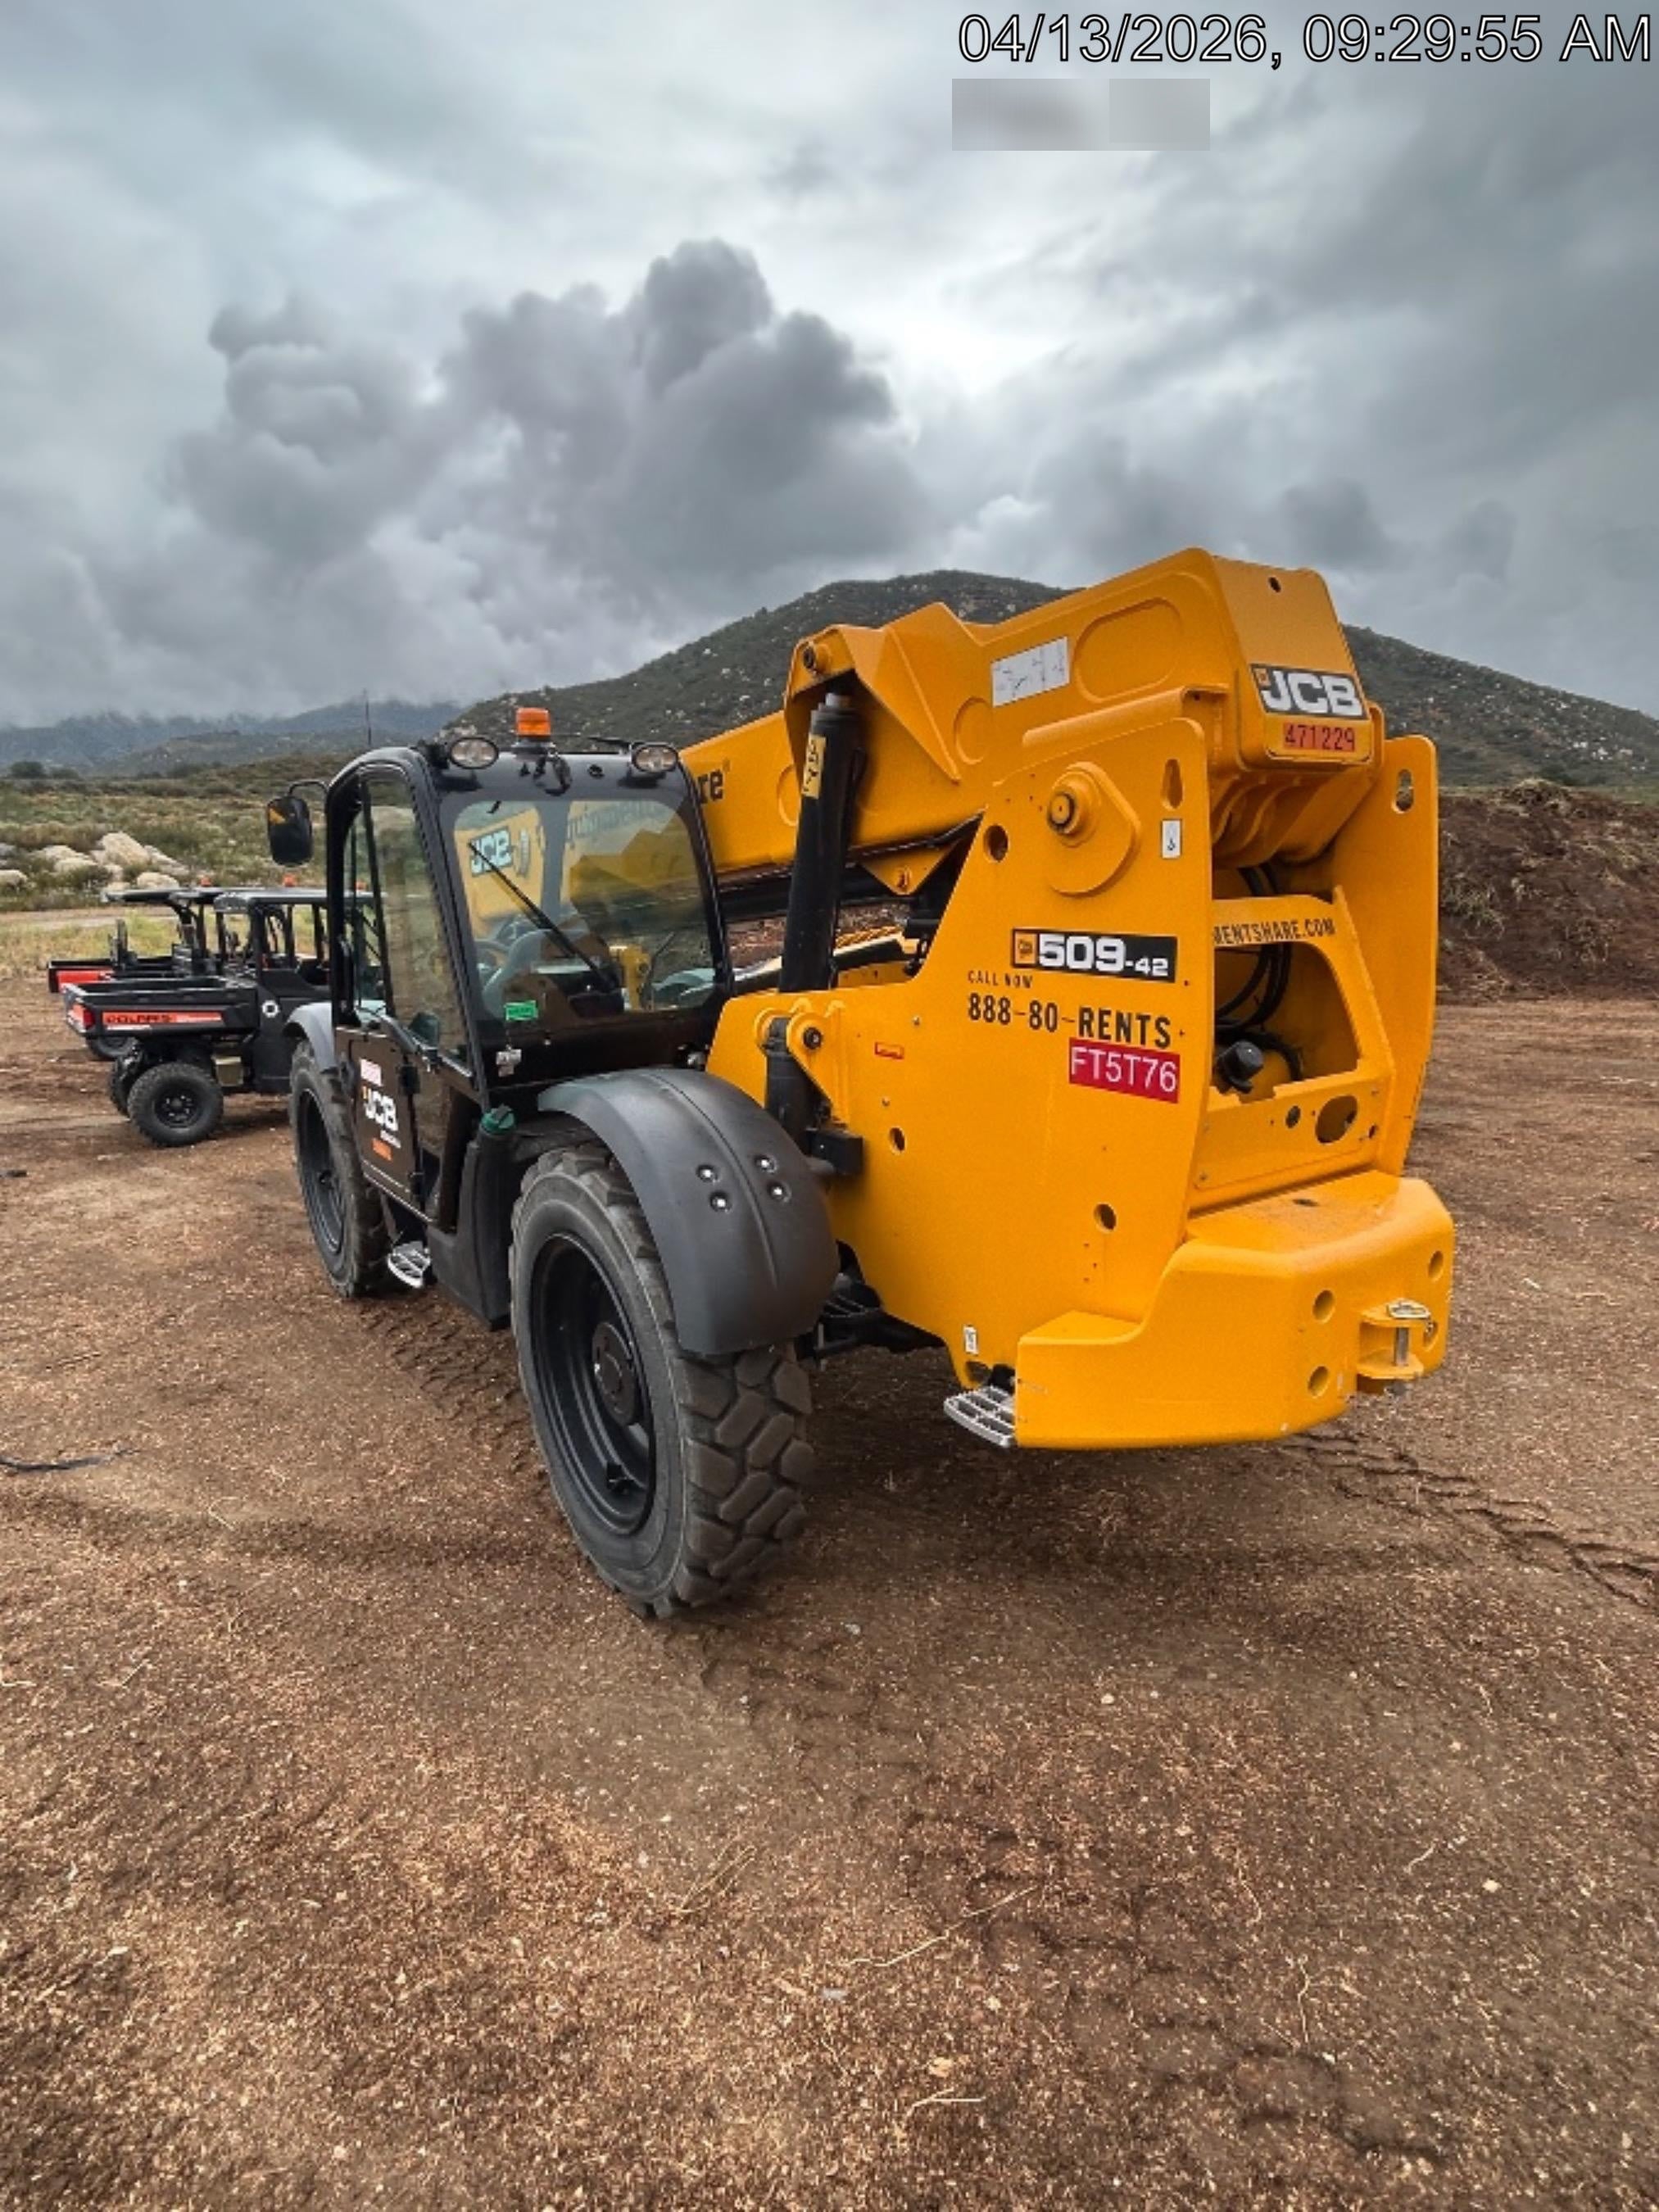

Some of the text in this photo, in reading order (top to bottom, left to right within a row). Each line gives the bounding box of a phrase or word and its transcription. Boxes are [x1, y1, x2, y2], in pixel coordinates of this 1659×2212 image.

[1260, 670, 1362, 716] JCB
[1285, 724, 1354, 752] 471229
[1038, 934, 1168, 977] 509-42
[968, 970, 1033, 989] CALL NOW
[1071, 1046, 1177, 1093] FT5T76
[364, 1088, 399, 1131] JCB
